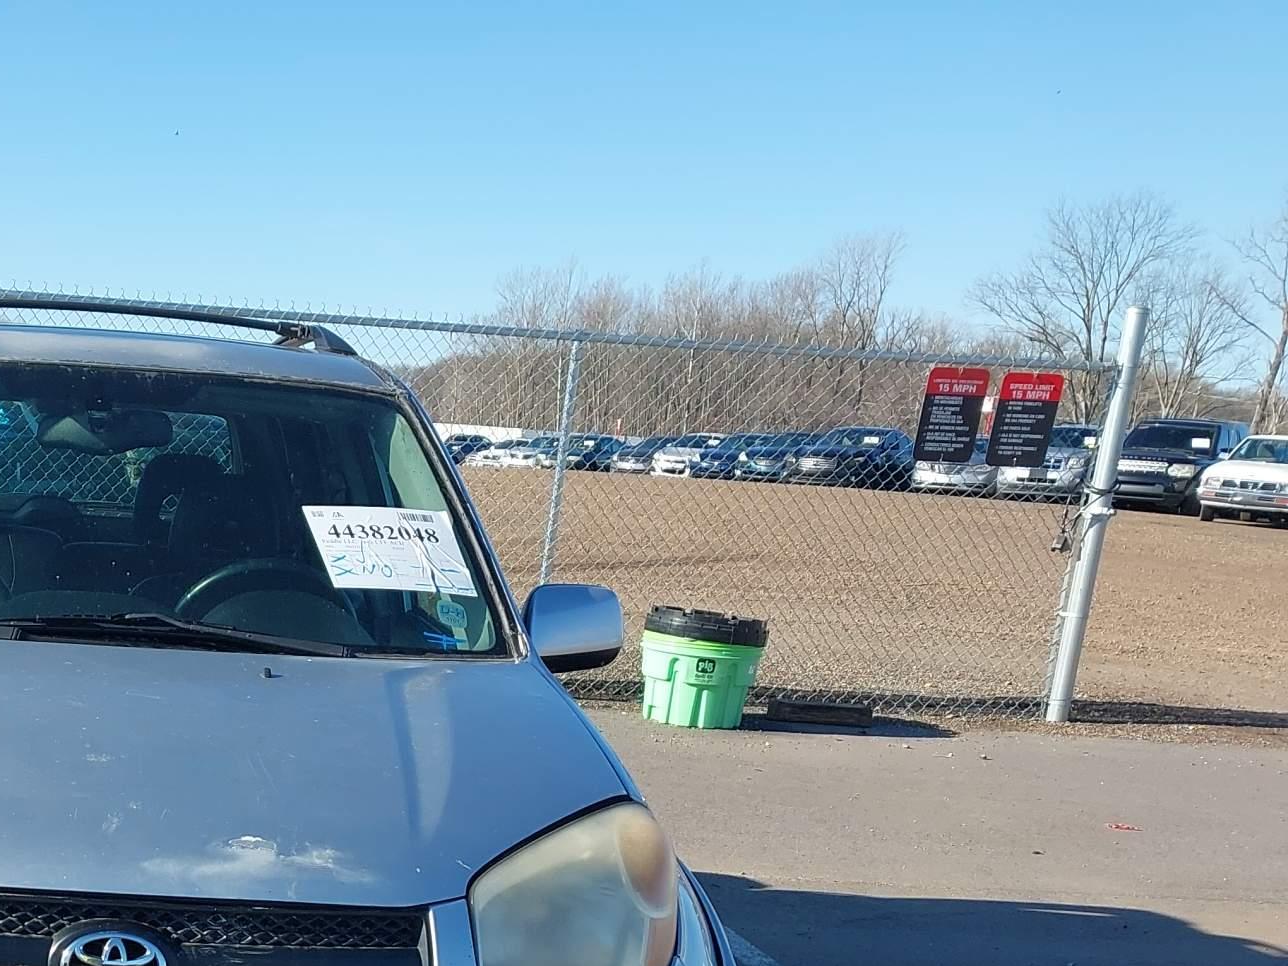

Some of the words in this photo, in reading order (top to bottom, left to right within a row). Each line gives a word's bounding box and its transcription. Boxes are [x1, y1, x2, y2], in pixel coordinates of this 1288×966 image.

[938, 383, 950, 393] 15
[952, 384, 977, 394] MPH
[1012, 390, 1023, 399] 15
[1025, 391, 1050, 400] MPH
[328, 523, 440, 544] 44382048
